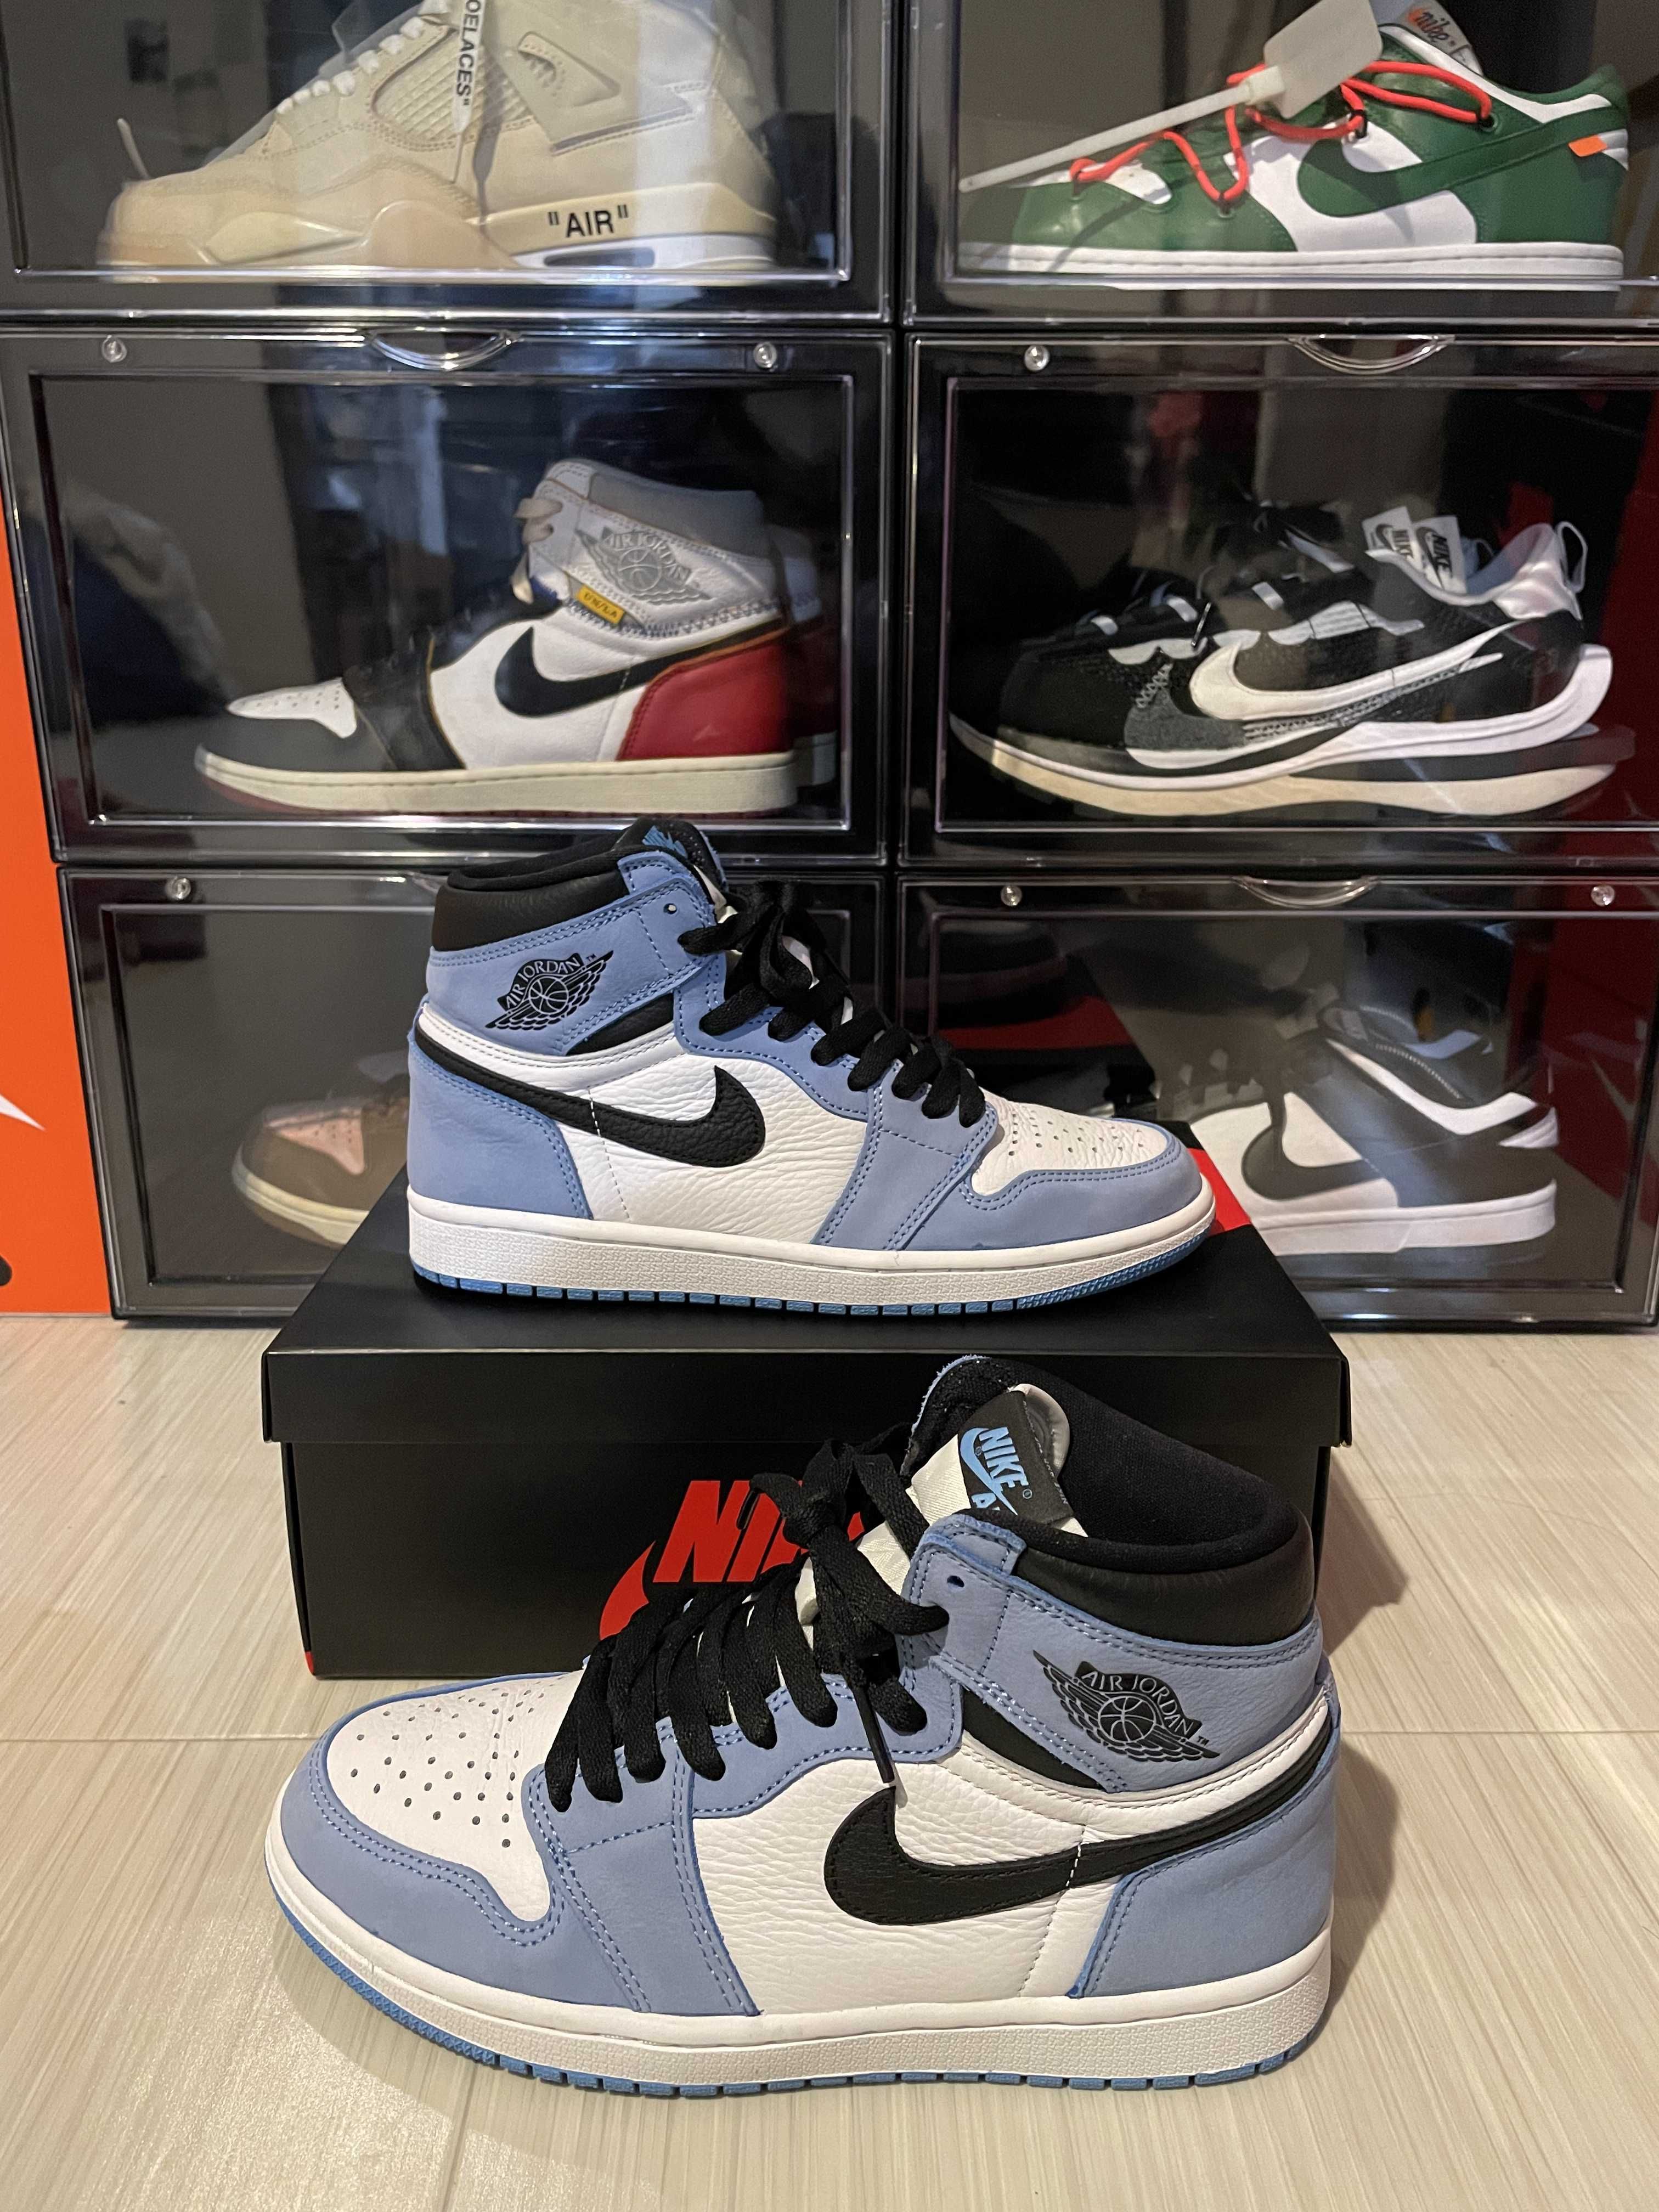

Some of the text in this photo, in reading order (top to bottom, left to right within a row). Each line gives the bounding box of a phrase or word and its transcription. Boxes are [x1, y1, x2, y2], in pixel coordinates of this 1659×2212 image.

[548, 204, 629, 238] "AIR"
[506, 983, 526, 1009] AIR
[518, 956, 581, 983] JORDAN
[979, 1426, 1029, 1488] NIKE
[1081, 1671, 1123, 1691] AIR
[1131, 1674, 1194, 1735] JORDAN
